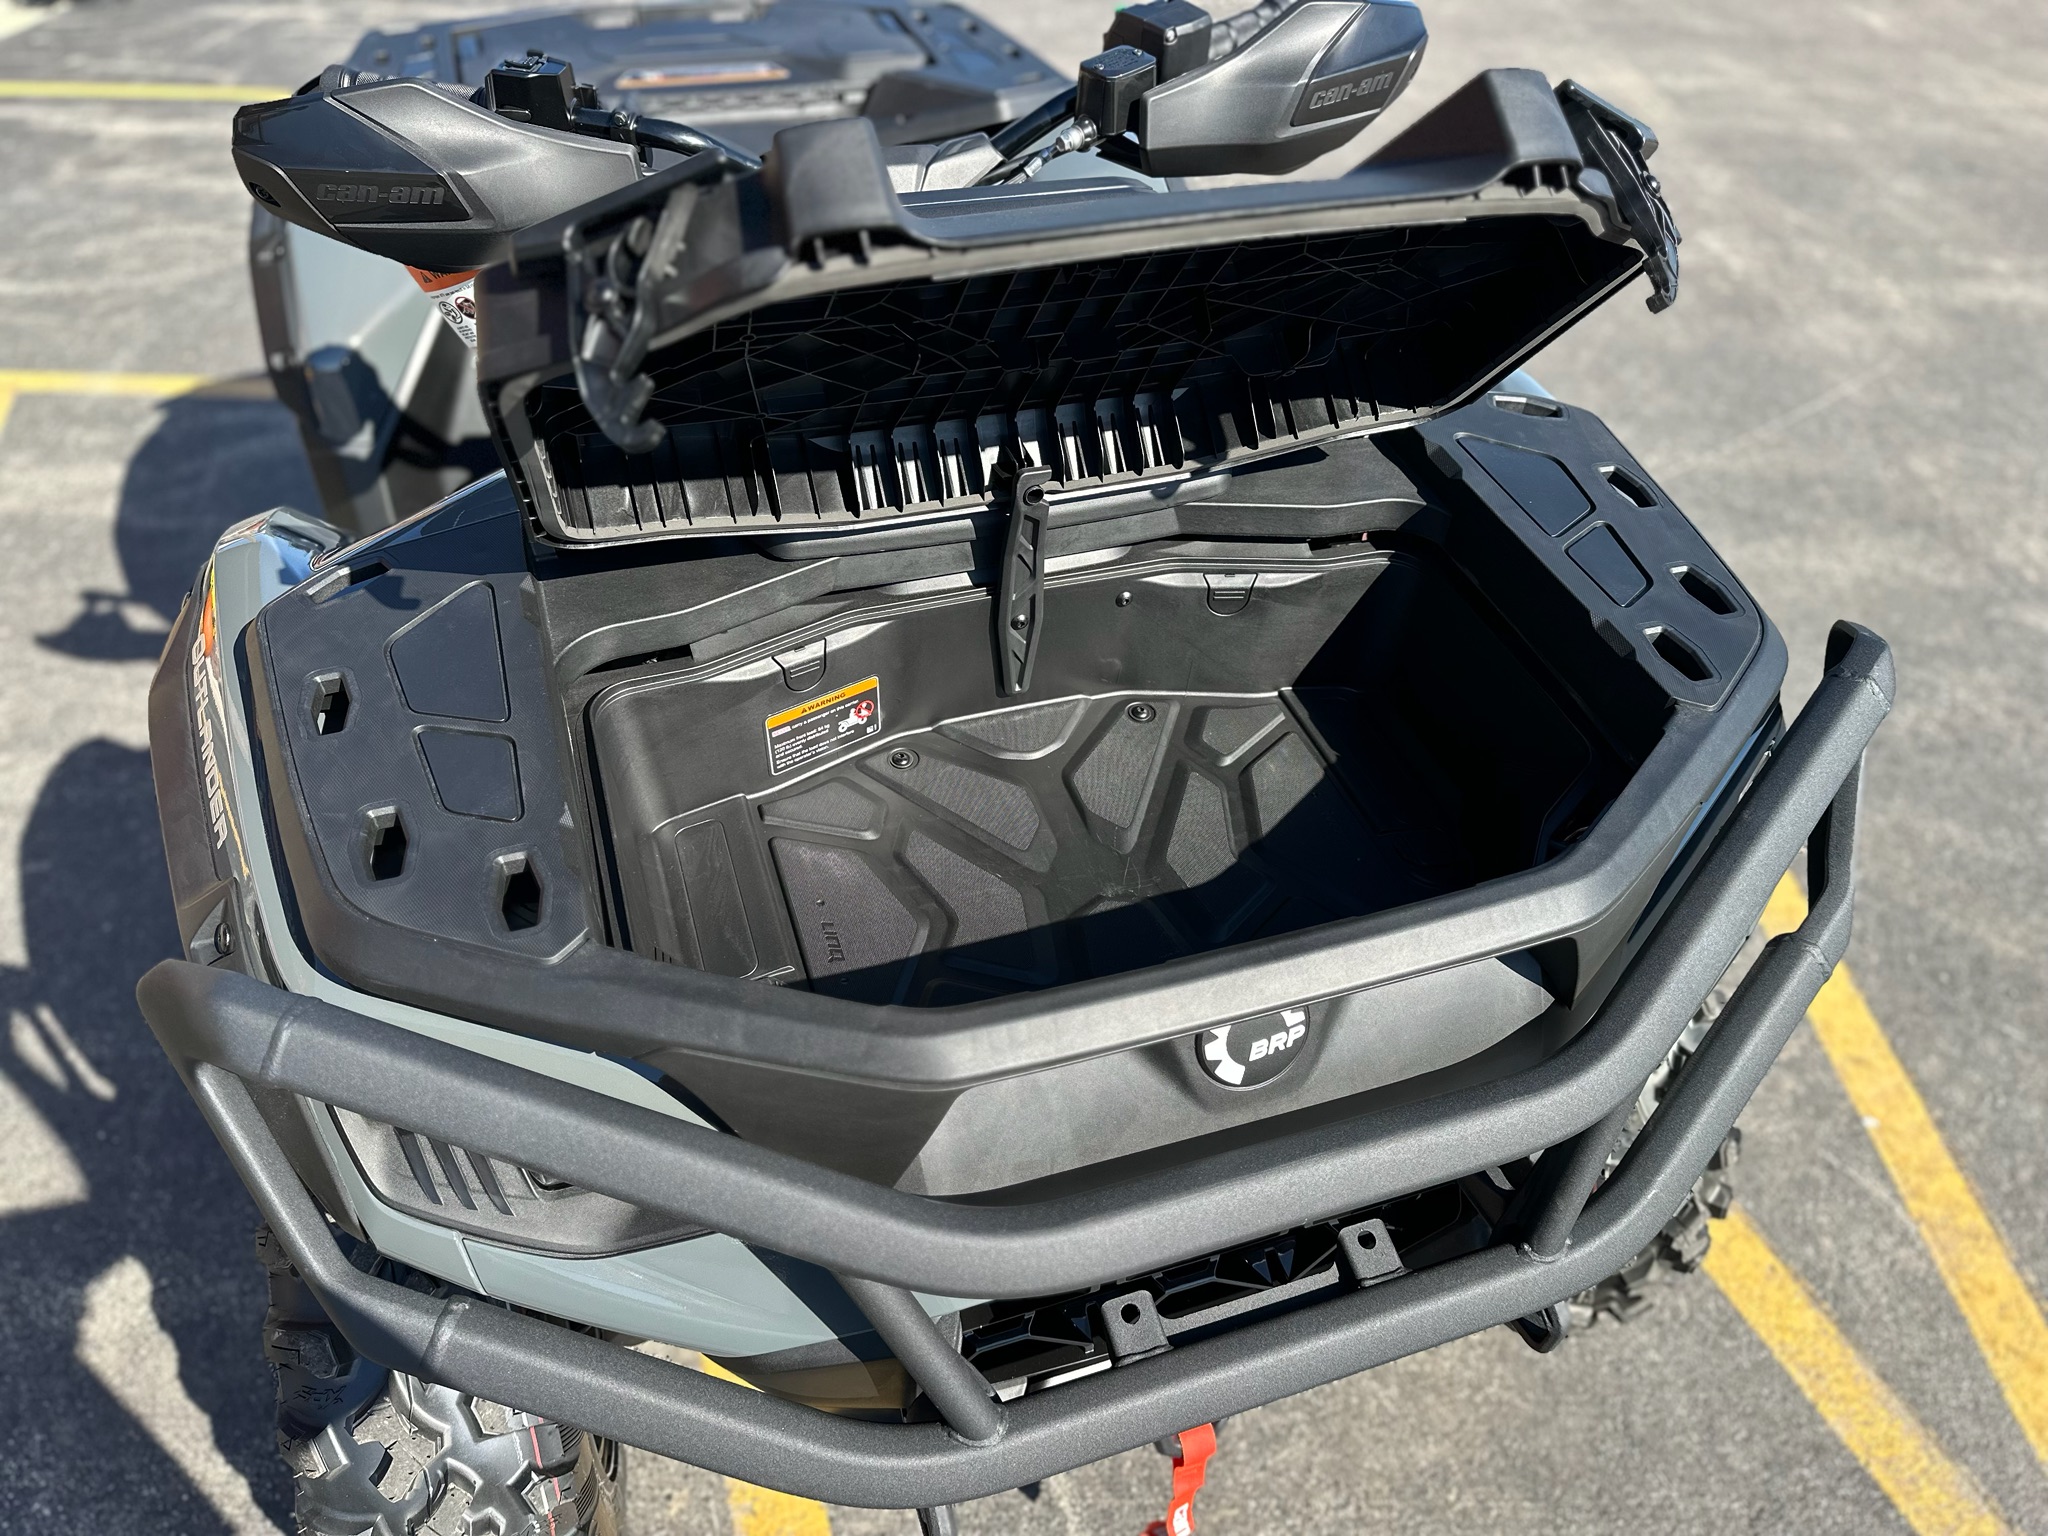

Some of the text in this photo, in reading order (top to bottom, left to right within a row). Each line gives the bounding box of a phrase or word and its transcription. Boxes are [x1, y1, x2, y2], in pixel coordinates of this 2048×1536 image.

[1309, 72, 1394, 110] can-am
[316, 183, 445, 205] can-am
[807, 692, 846, 711] WARNING
[192, 632, 228, 850] OUTLANDER
[1248, 1024, 1306, 1062] BRP
